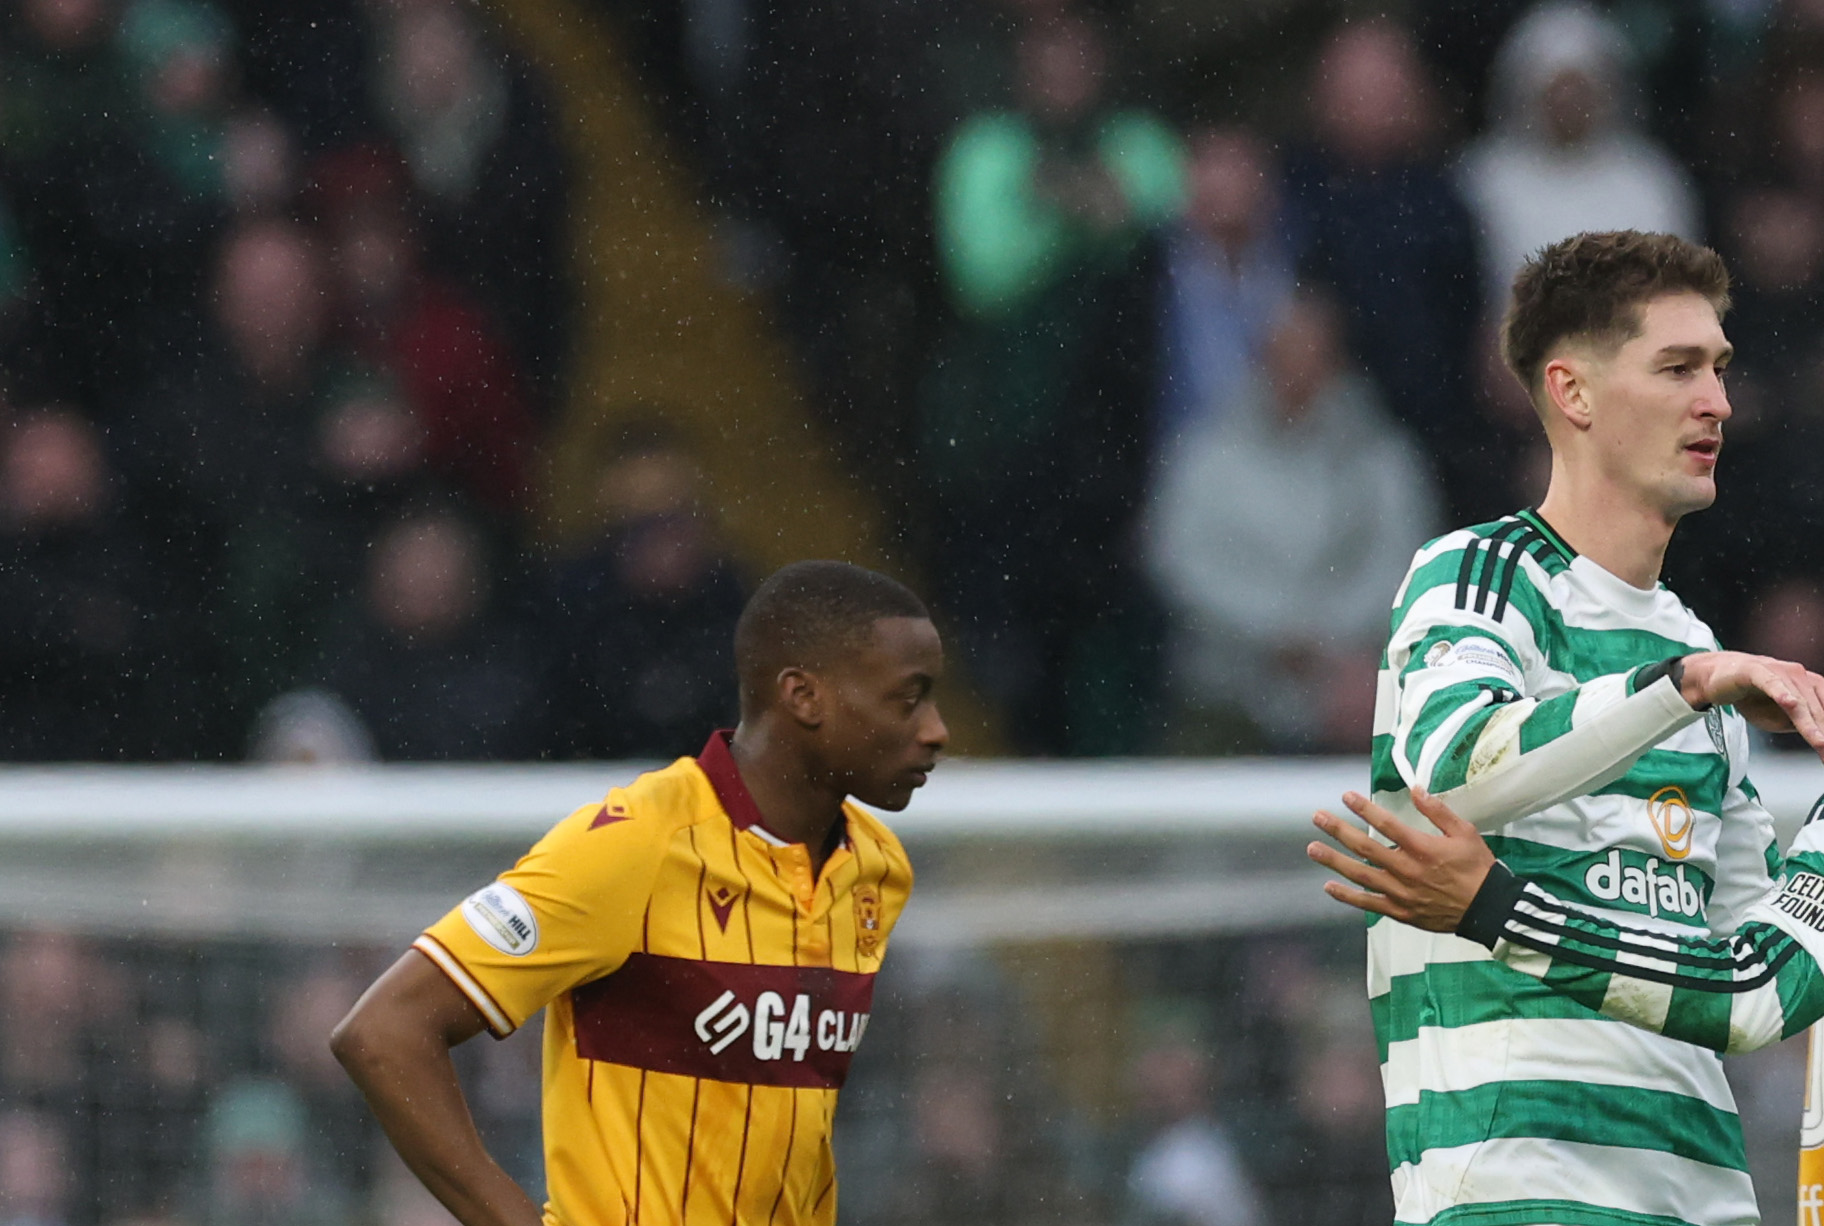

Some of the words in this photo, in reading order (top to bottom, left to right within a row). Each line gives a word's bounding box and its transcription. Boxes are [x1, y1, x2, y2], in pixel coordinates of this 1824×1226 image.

[1585, 849, 1708, 922] dafab
[508, 915, 532, 941] HILL
[752, 990, 812, 1062] G4
